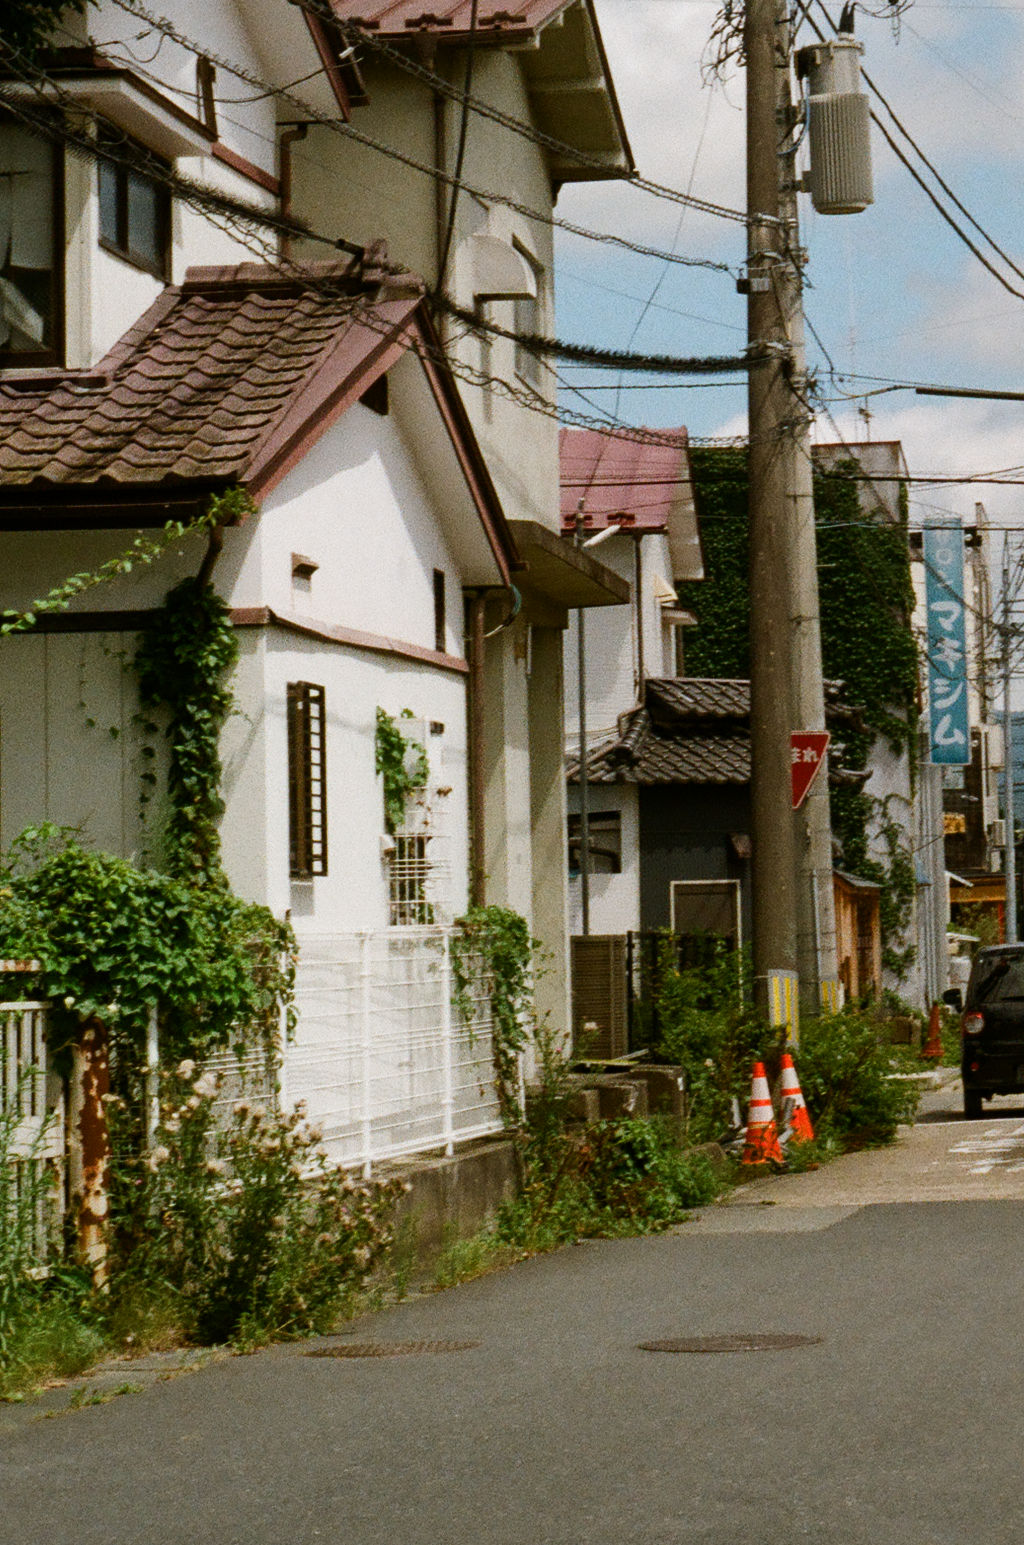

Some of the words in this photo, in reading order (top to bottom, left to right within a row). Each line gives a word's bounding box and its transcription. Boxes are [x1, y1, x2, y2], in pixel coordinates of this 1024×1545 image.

[931, 600, 966, 746] マキシム
[791, 746, 820, 764] まれ
